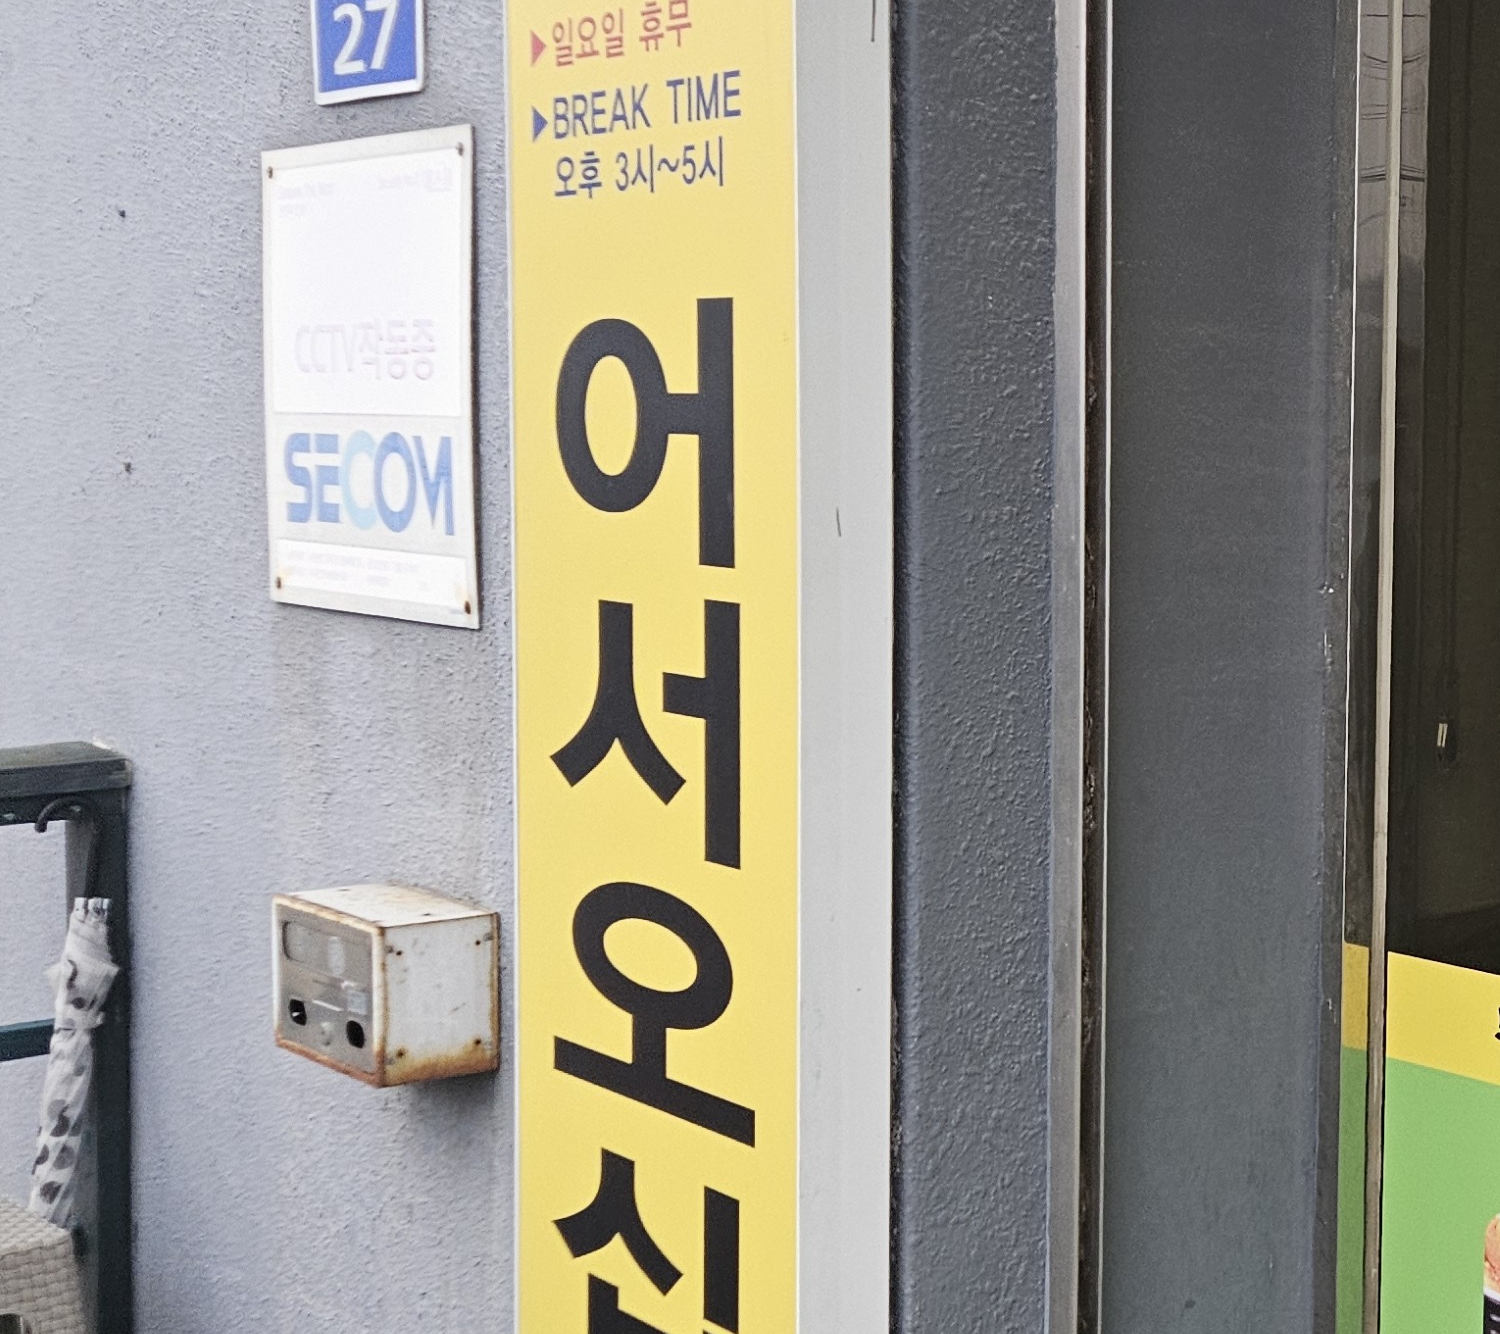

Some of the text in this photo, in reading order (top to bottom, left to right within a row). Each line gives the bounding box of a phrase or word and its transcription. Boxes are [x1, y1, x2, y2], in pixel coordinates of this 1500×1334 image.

[552, 8, 625, 68] 일요일
[553, 69, 742, 140] BREAK TIME
[554, 135, 724, 199] 오후 3시~5시
[283, 430, 456, 537] SECOM
